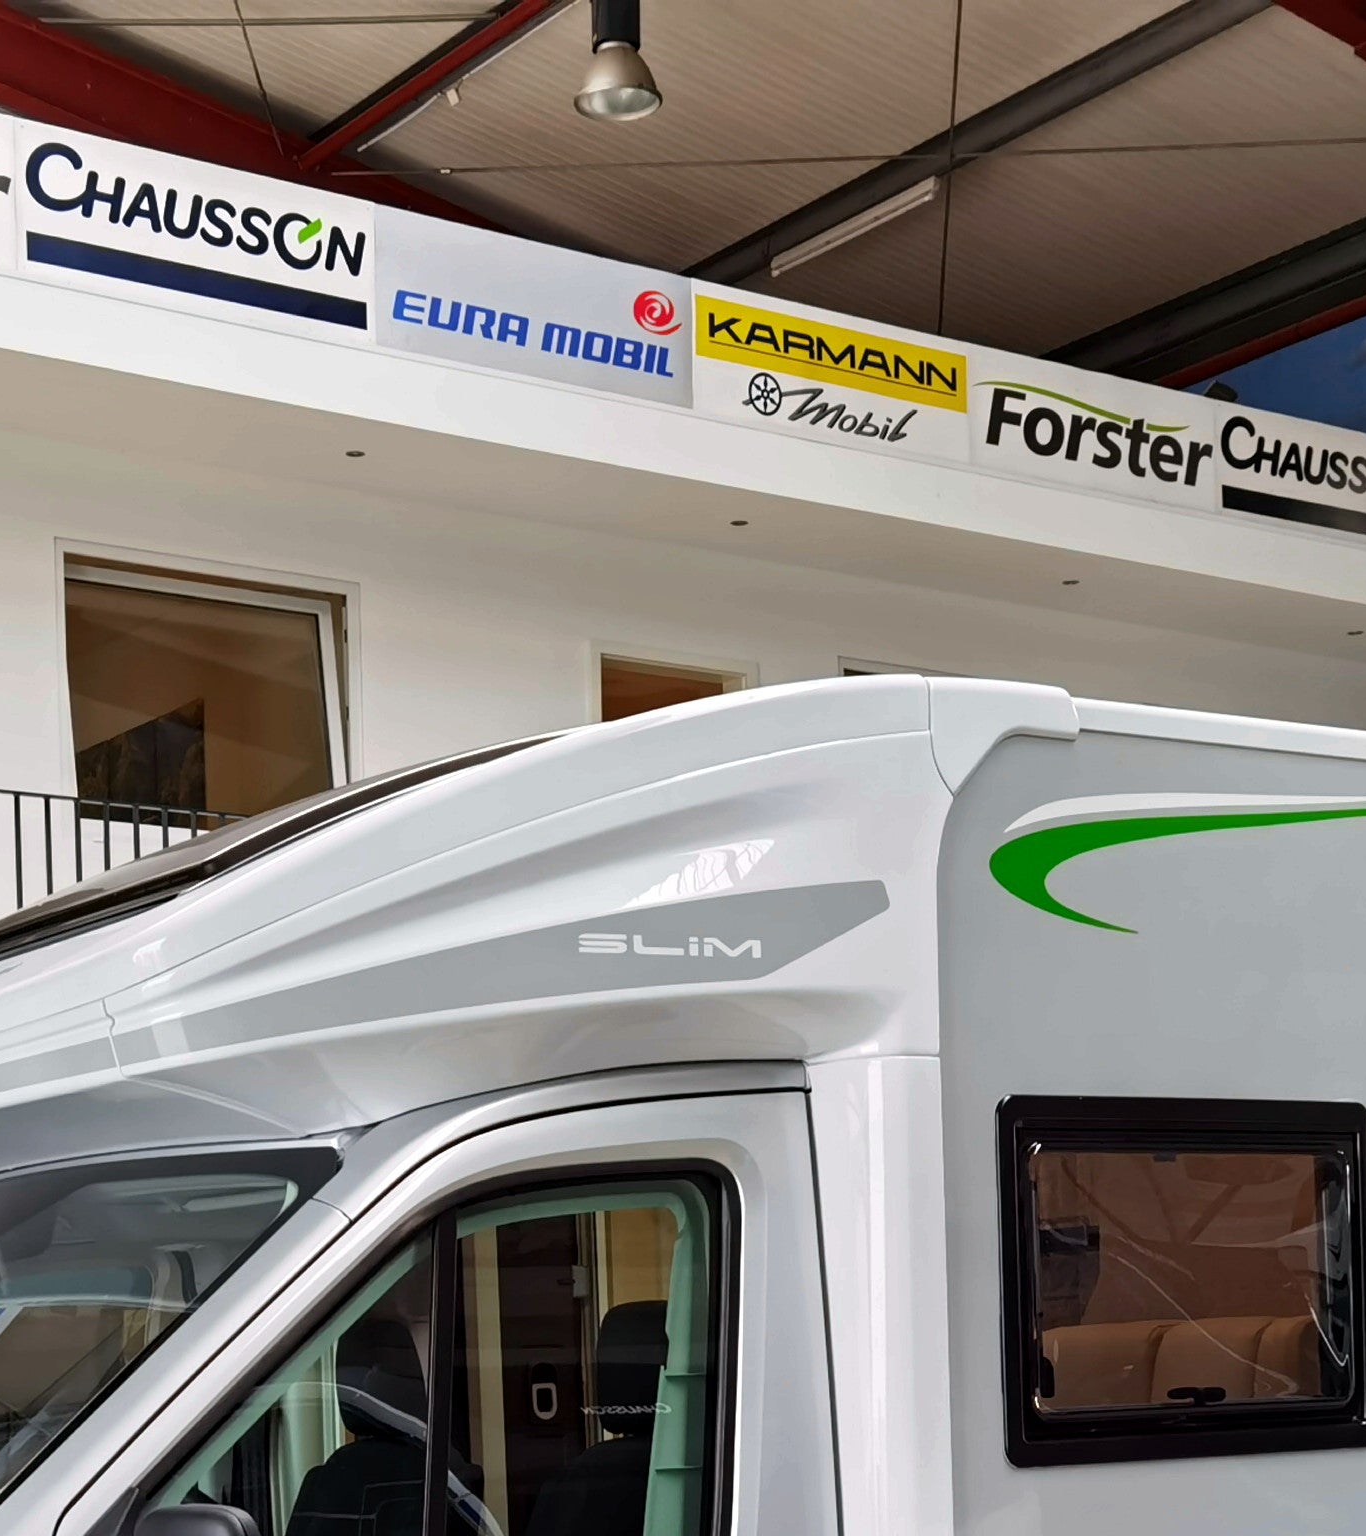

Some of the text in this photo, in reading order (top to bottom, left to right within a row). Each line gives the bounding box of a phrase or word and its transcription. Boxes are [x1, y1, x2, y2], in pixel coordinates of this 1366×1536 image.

[25, 143, 366, 278] CHAUSSON
[392, 289, 674, 378] EURA MOBIL
[708, 313, 957, 391] KARMANN
[985, 388, 1213, 487] Forster
